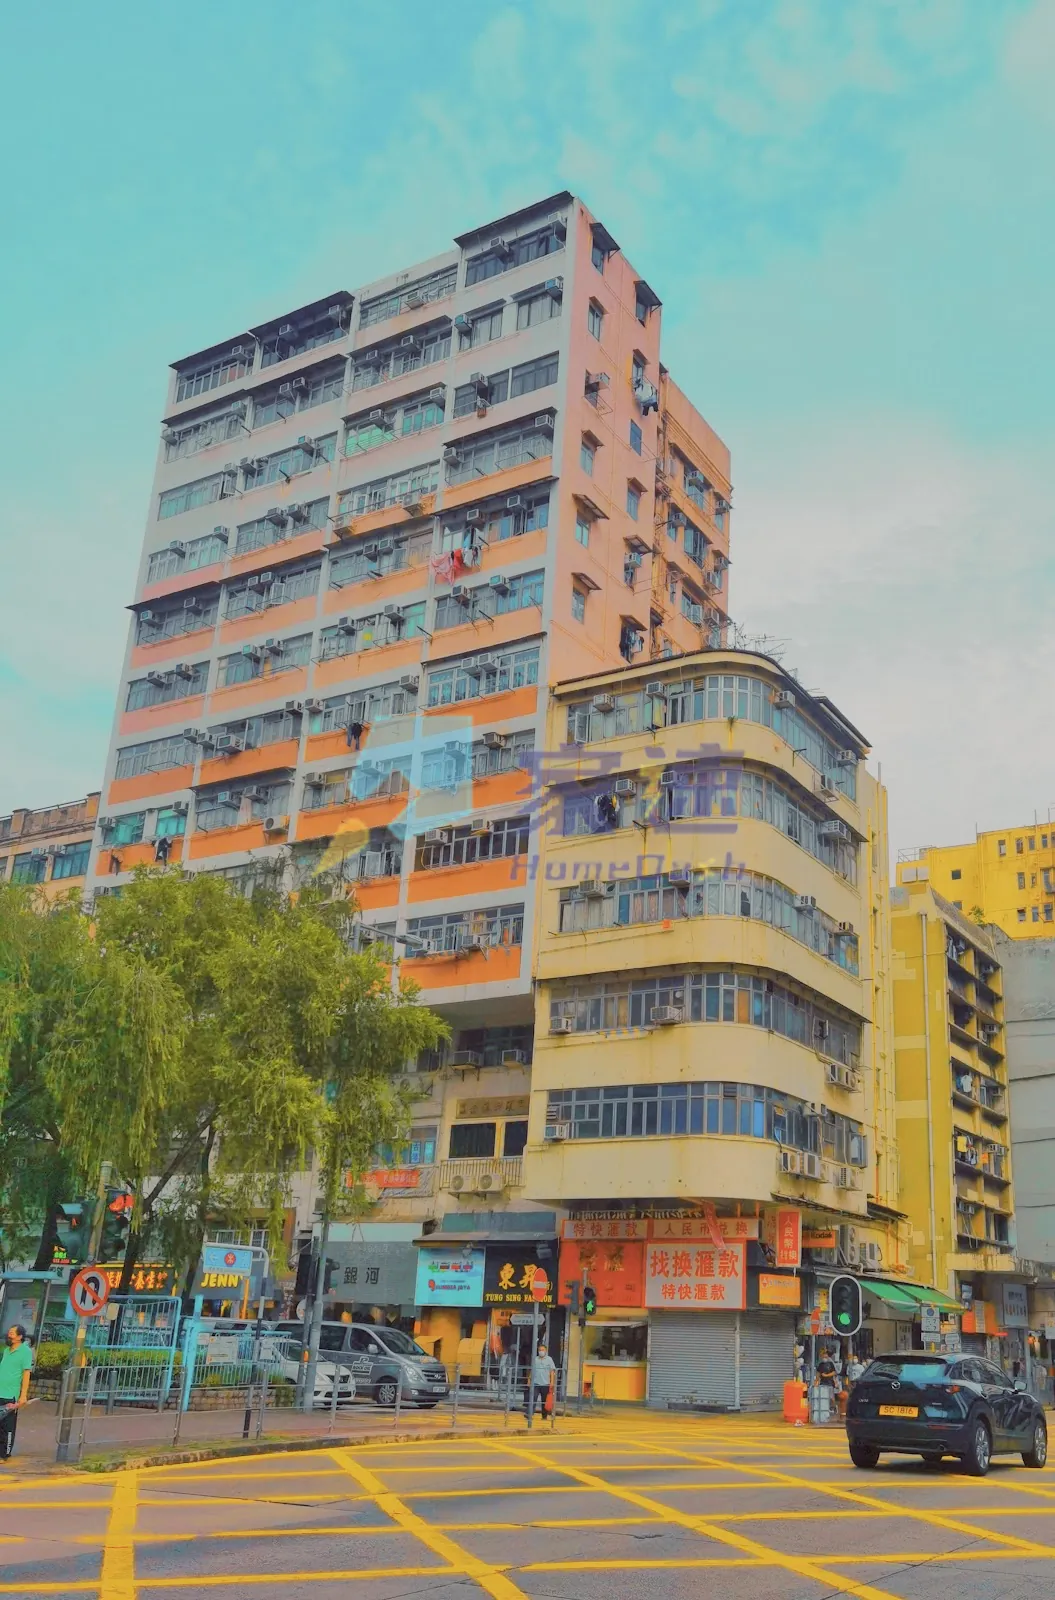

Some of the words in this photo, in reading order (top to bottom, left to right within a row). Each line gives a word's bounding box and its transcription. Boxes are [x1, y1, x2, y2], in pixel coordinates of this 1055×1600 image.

[343, 1266, 381, 1285] 銀河
[485, 1293, 503, 1302] TUNG
[505, 1293, 522, 1302] SING
[883, 1406, 895, 1414] SC
[897, 1406, 914, 1415] 1816
